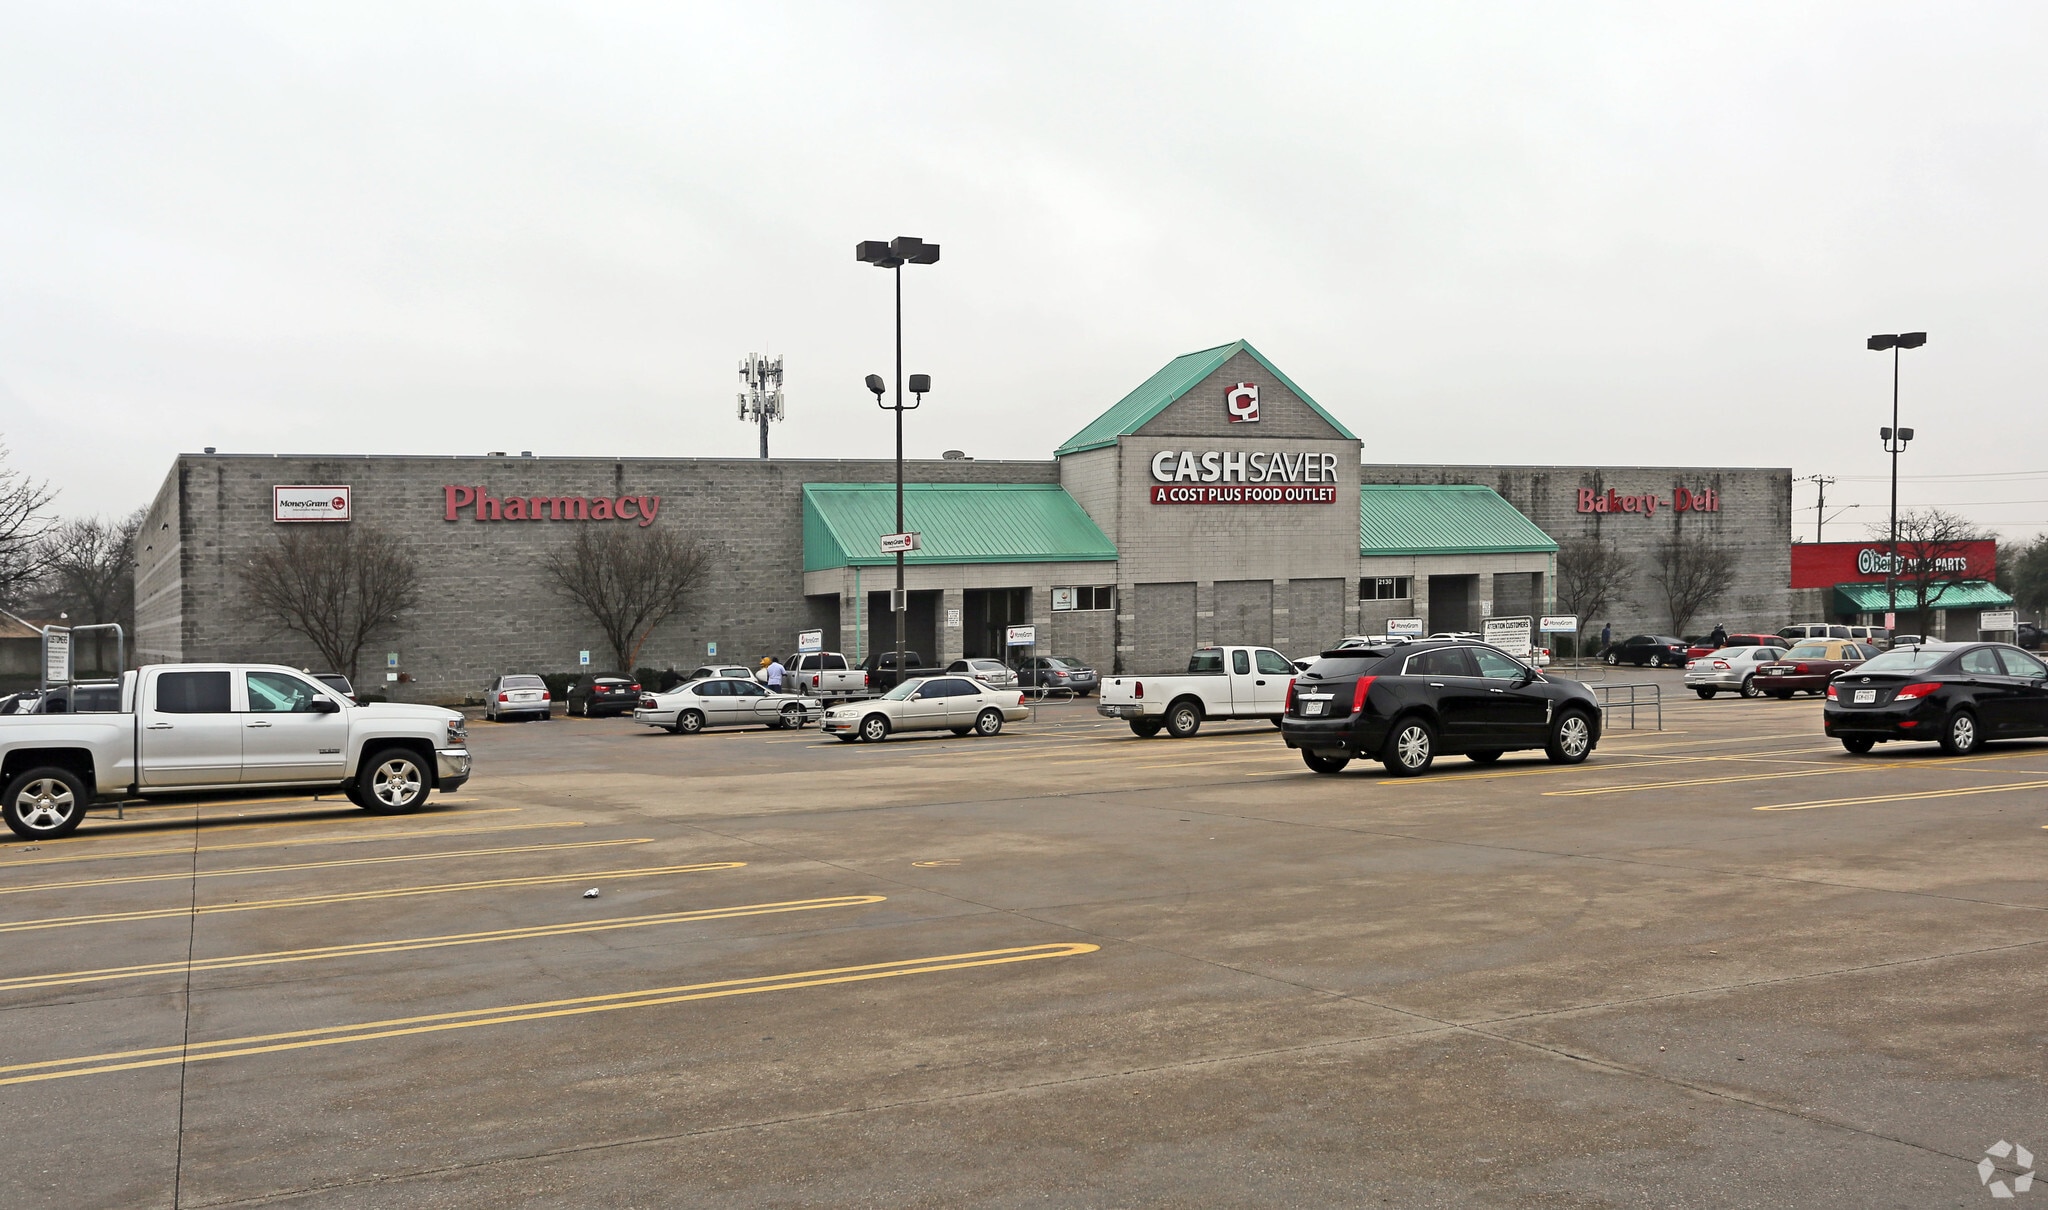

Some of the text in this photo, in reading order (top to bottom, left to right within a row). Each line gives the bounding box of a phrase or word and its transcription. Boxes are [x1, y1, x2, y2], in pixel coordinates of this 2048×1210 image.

[1156, 488, 1334, 501] A COST PLUS FOOD OUTLET
[1674, 487, 1719, 512] Deli
[279, 500, 328, 508] MoneyGram
[443, 484, 661, 527] Pharmacy
[1935, 557, 1967, 571] PARTS
[1506, 621, 1529, 629] CUSTOMERS
